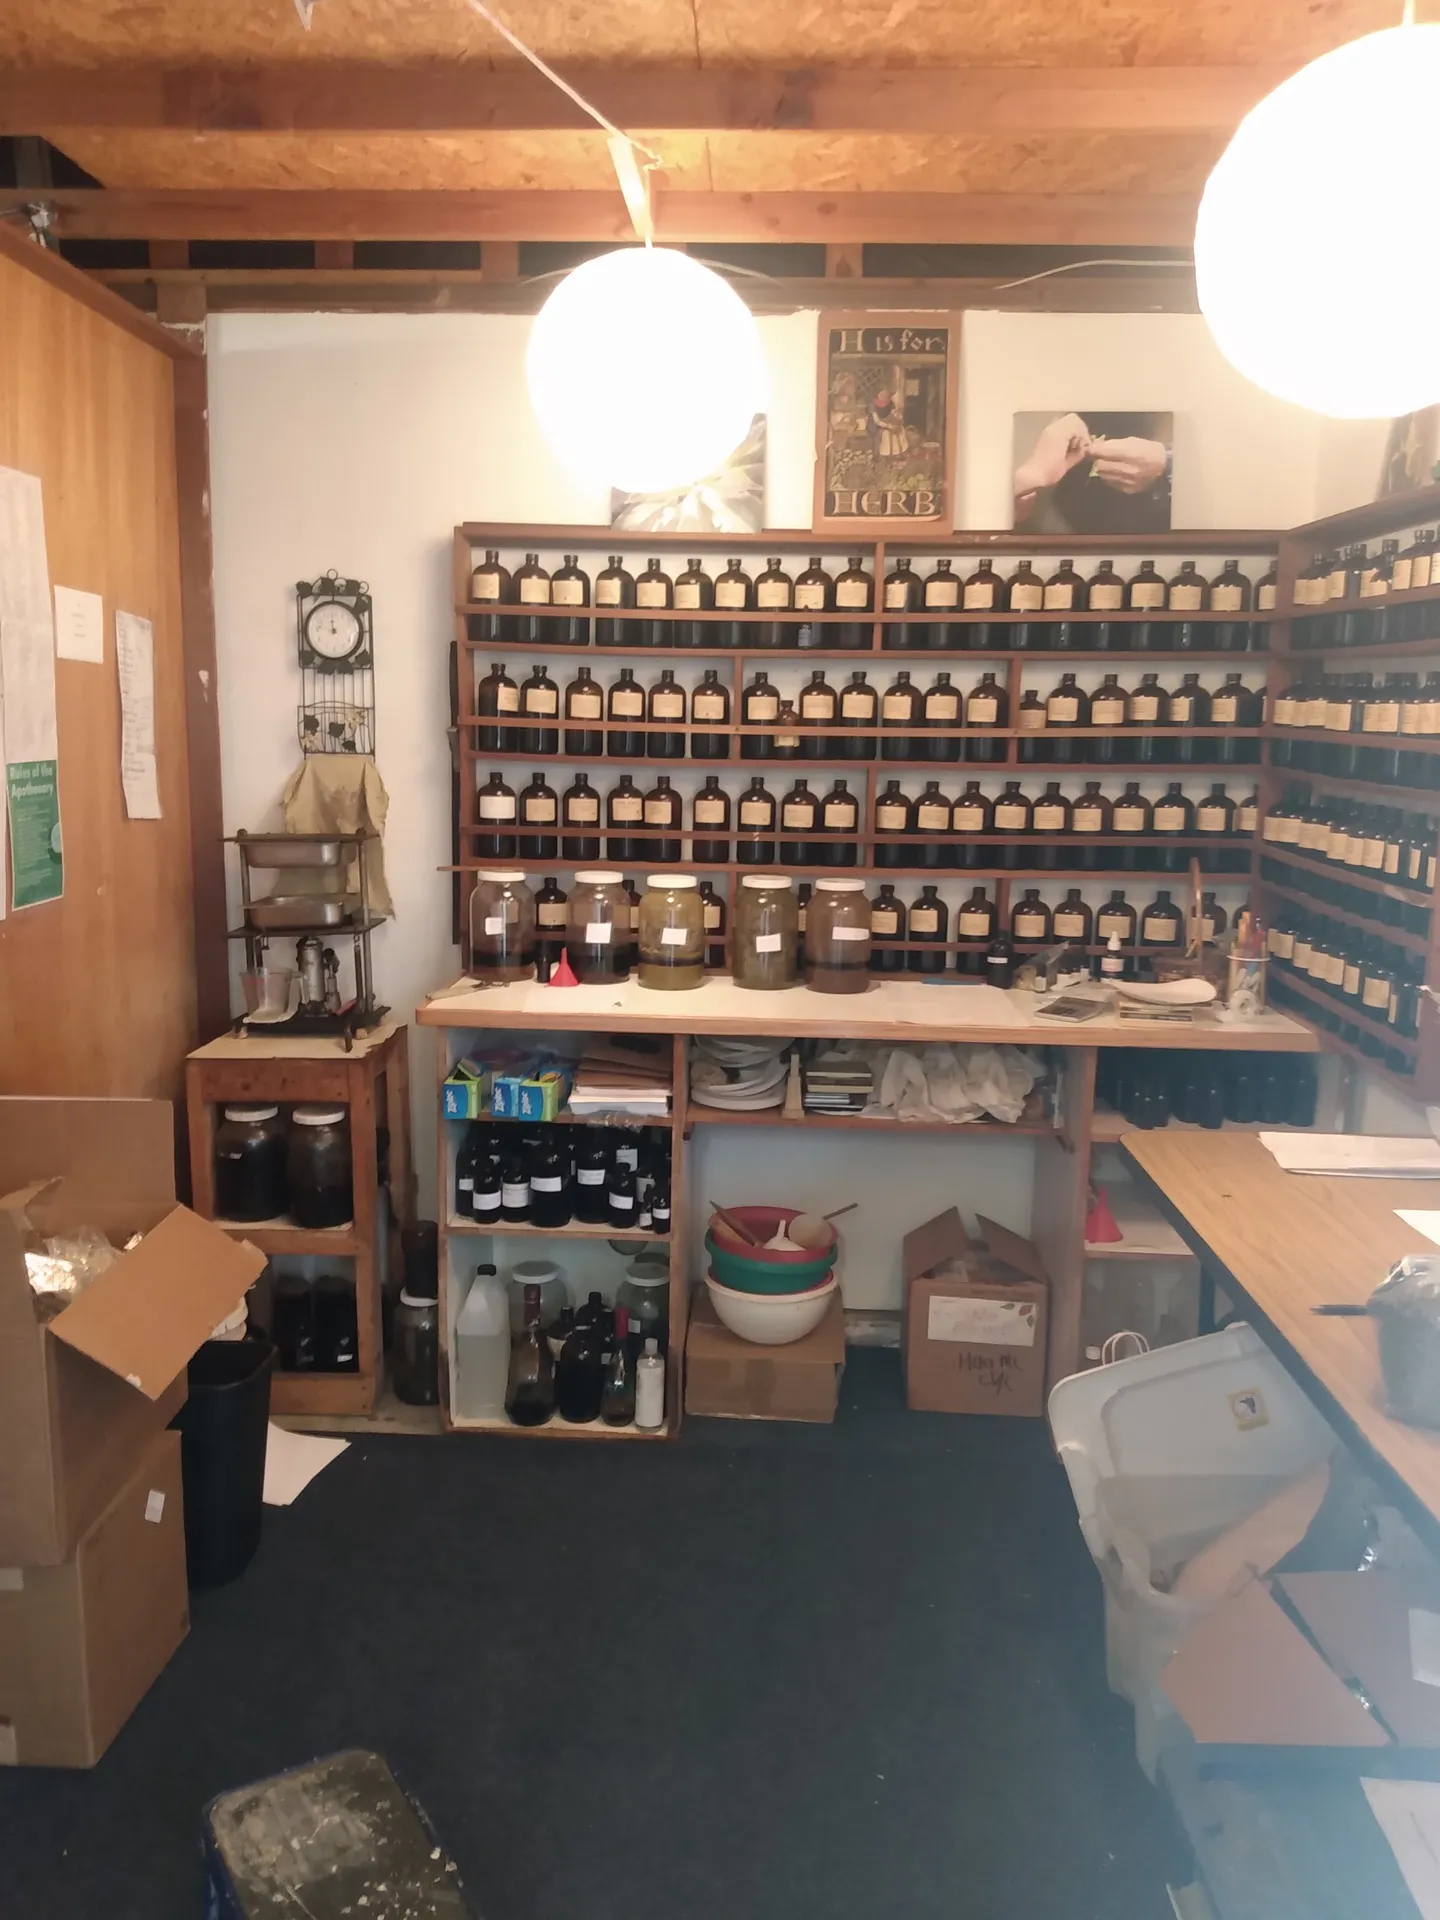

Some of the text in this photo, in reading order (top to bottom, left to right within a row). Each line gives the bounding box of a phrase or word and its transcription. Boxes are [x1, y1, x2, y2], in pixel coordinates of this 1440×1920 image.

[840, 328, 945, 352] H is for
[833, 490, 936, 516] HERB
[32, 764, 39, 778] of
[41, 763, 53, 777] the
[446, 1089, 458, 1114] Ziploc
[494, 1086, 506, 1113] Ziploc
[521, 1090, 532, 1115] Ziploc
